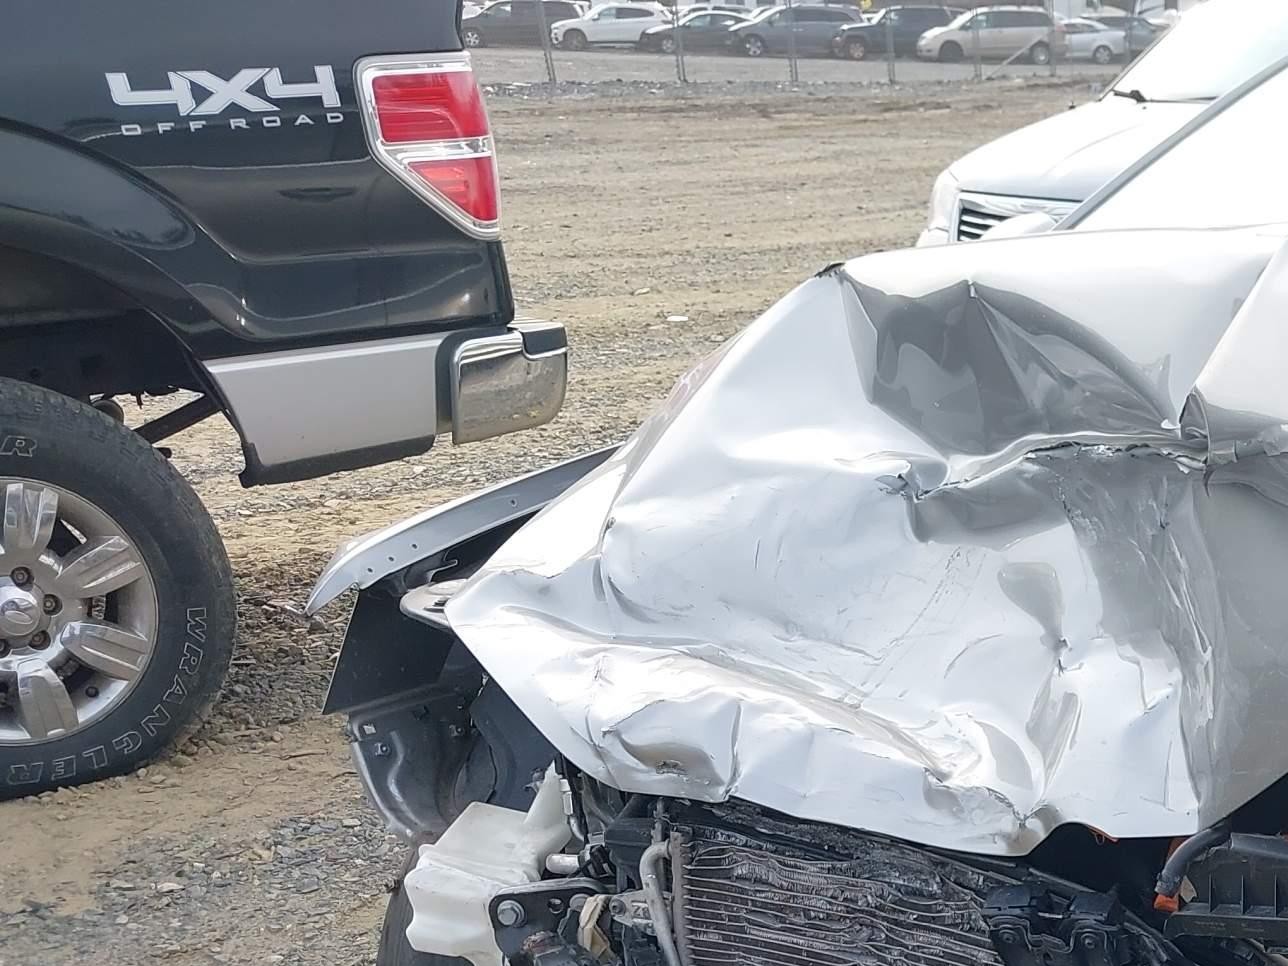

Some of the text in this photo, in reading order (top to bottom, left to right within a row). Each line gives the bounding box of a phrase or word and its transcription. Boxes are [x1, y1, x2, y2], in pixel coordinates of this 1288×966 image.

[105, 65, 341, 116] 4X4
[120, 112, 345, 136] OFF ROAD
[7, 607, 207, 785] WRANGLER
